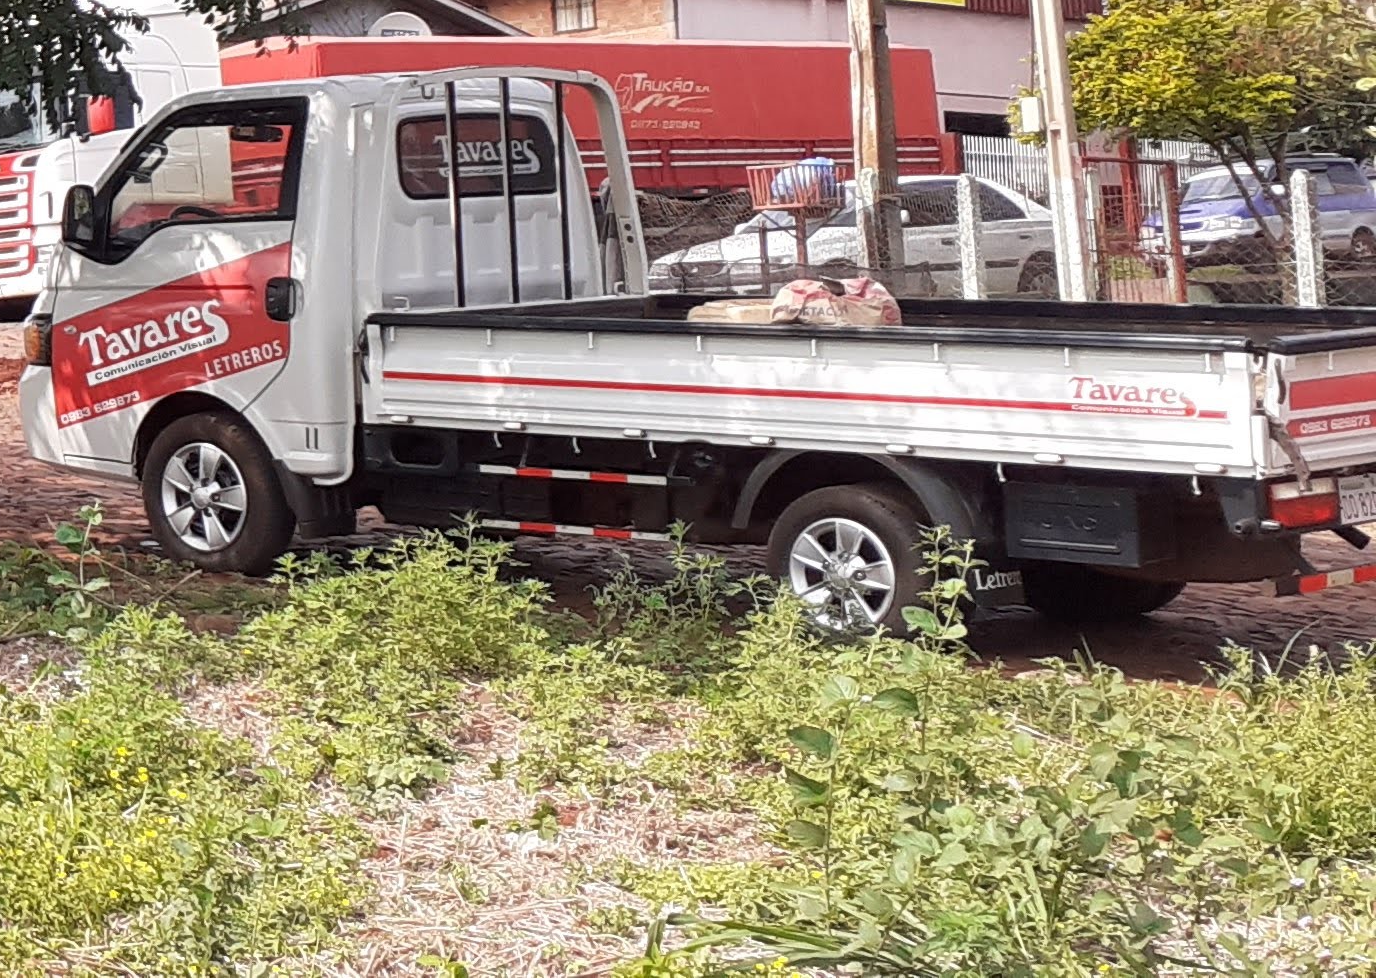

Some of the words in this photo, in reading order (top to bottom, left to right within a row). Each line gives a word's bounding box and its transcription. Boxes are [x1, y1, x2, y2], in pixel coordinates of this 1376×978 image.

[78, 299, 230, 366] Tavares
[94, 349, 177, 380] Comunicación
[178, 335, 217, 353] Visual
[203, 339, 283, 378] LETREROS
[1069, 377, 1197, 414] Tavares
